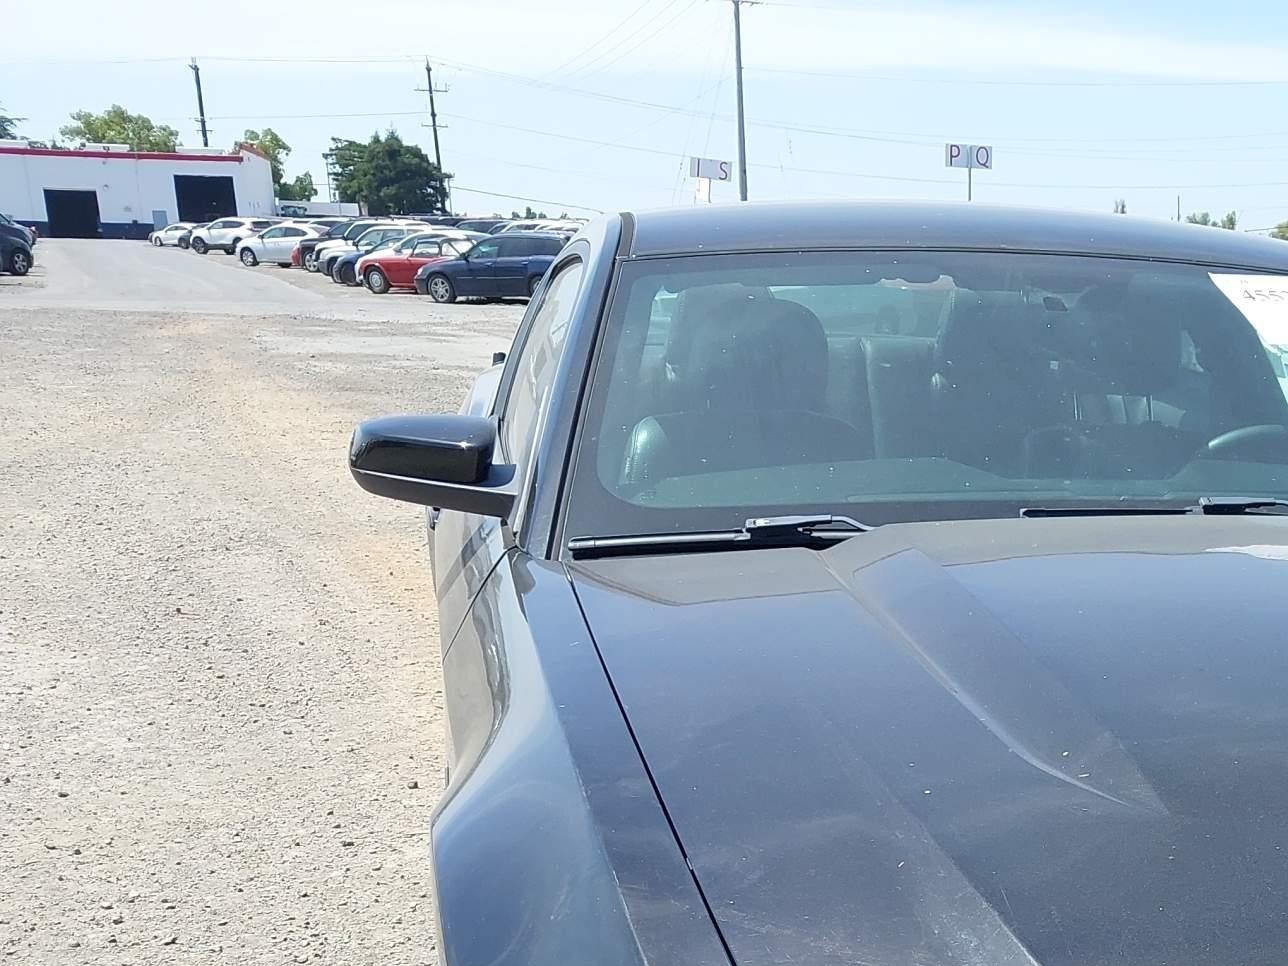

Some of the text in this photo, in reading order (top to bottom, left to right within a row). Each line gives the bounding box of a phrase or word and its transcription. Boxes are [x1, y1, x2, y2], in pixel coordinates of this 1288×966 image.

[950, 144, 989, 168] P Q
[719, 162, 729, 180] S
